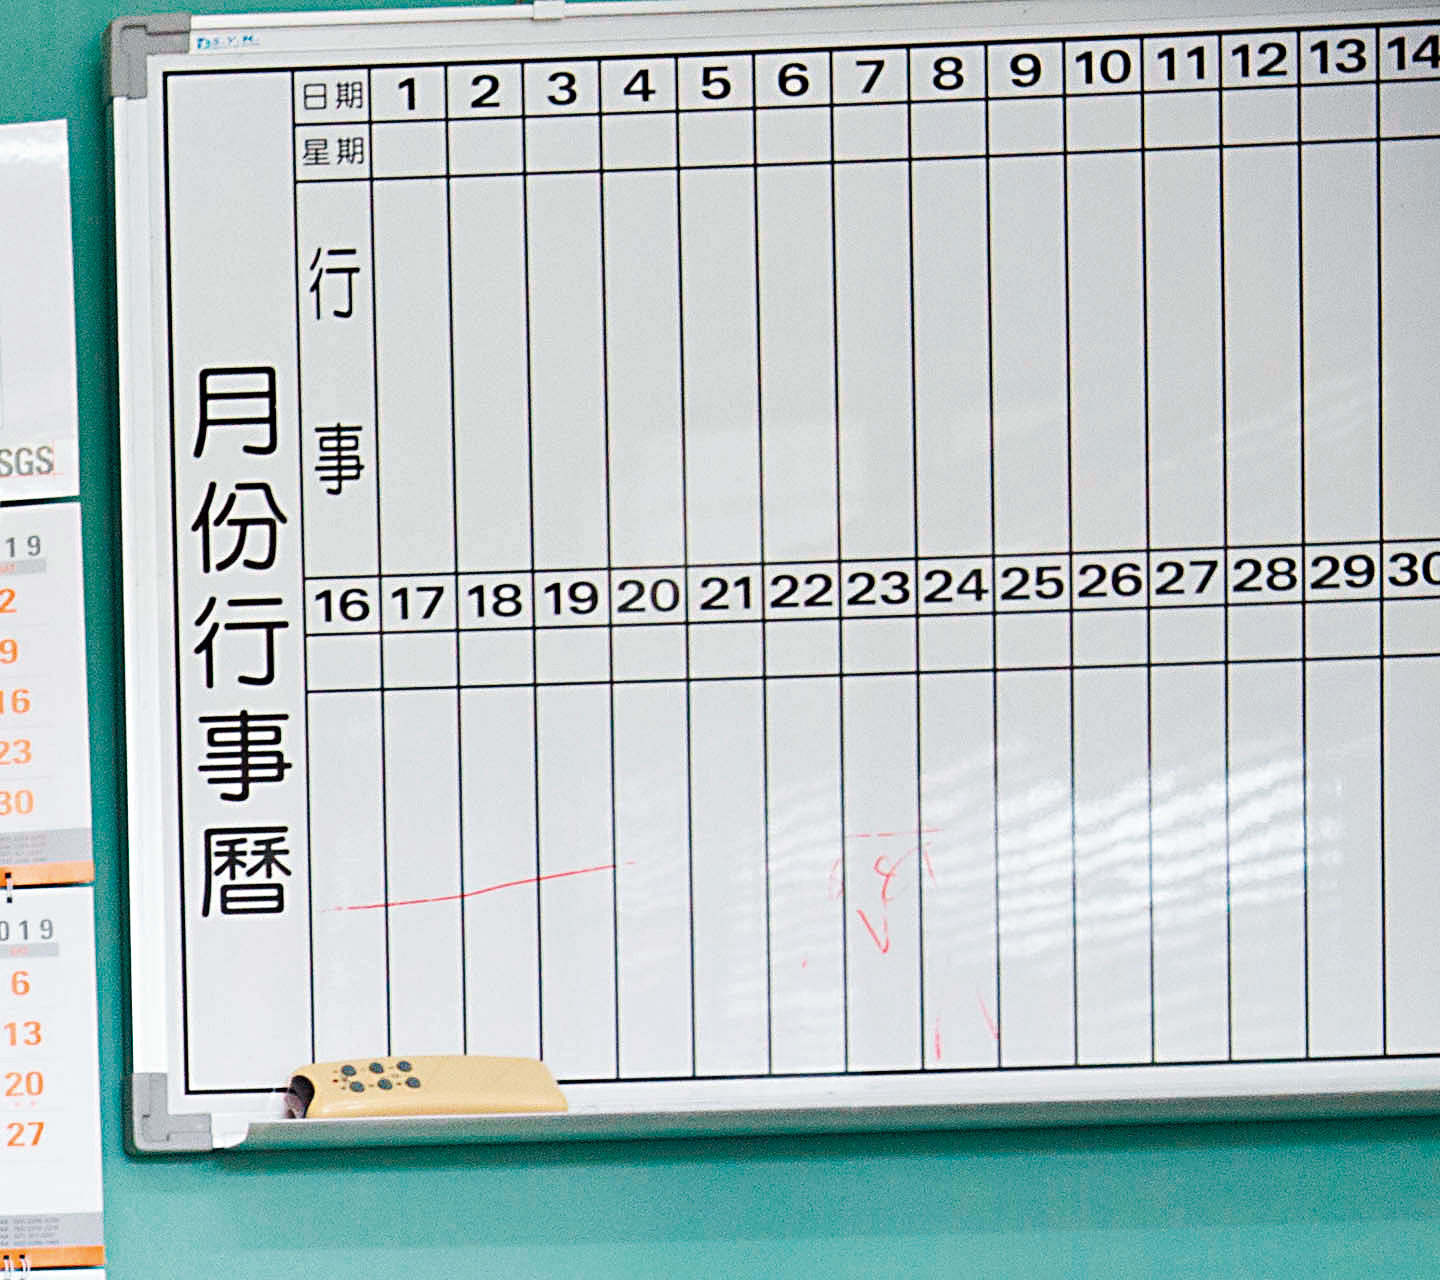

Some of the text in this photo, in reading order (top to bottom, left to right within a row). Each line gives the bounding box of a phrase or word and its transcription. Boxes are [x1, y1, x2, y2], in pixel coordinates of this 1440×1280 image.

[303, 35, 1440, 110] 日期 1 2 3 4 5 6 7 8 9 10 11 12 13 14
[303, 136, 364, 166] 星期
[309, 247, 364, 496] 行事
[315, 551, 1440, 622] 16 17 18 19 20 21 22 23 24 25 26 27 28 29 30
[0, 640, 18, 664] 9
[191, 366, 292, 918] 月份行事曆
[12, 971, 30, 995] 6
